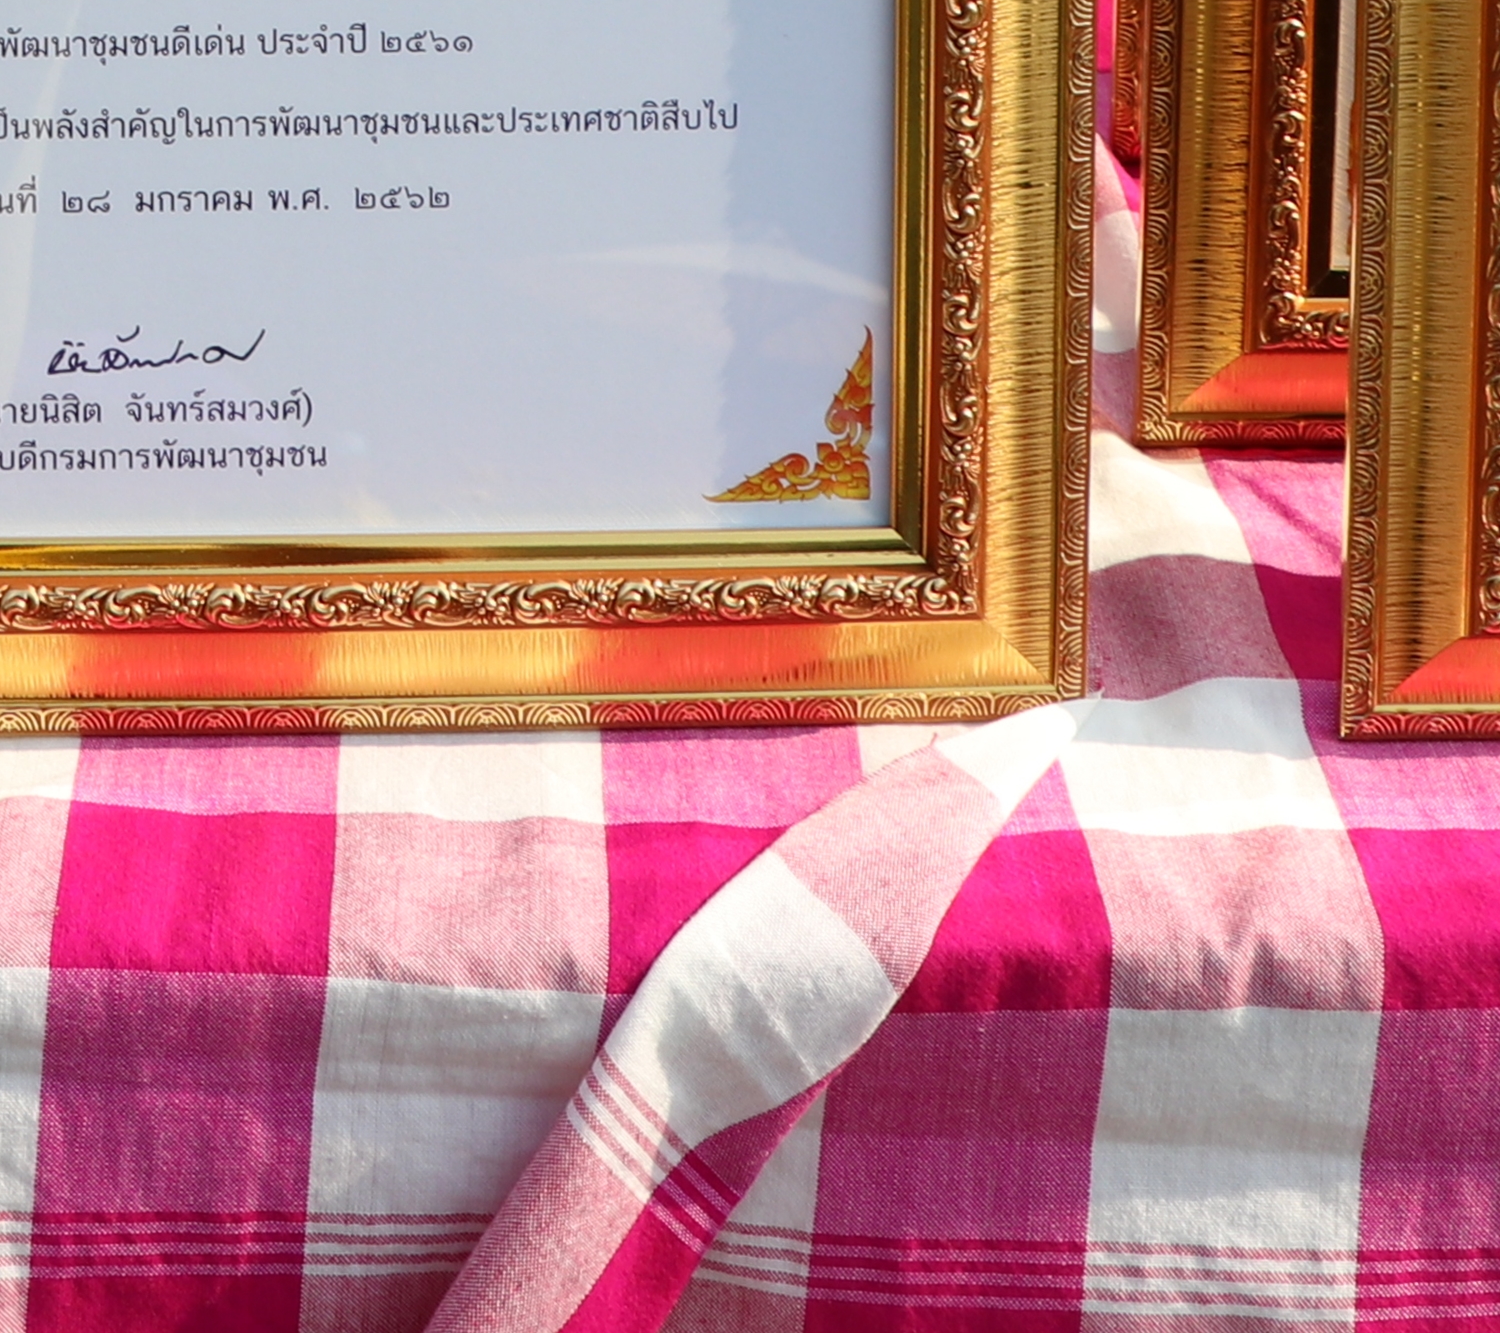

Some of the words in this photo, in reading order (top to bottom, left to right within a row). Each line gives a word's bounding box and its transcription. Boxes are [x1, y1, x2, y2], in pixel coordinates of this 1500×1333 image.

[256, 22, 367, 56] ประจำปี
[380, 29, 474, 54] ๒๕๖๑
[61, 189, 111, 214] ๒๘
[134, 189, 253, 213] มกราคม
[267, 186, 330, 211] พ.ศ.
[354, 185, 450, 210] ๒๕๖๒
[124, 386, 313, 428] จันทร์สมวงศ์)
